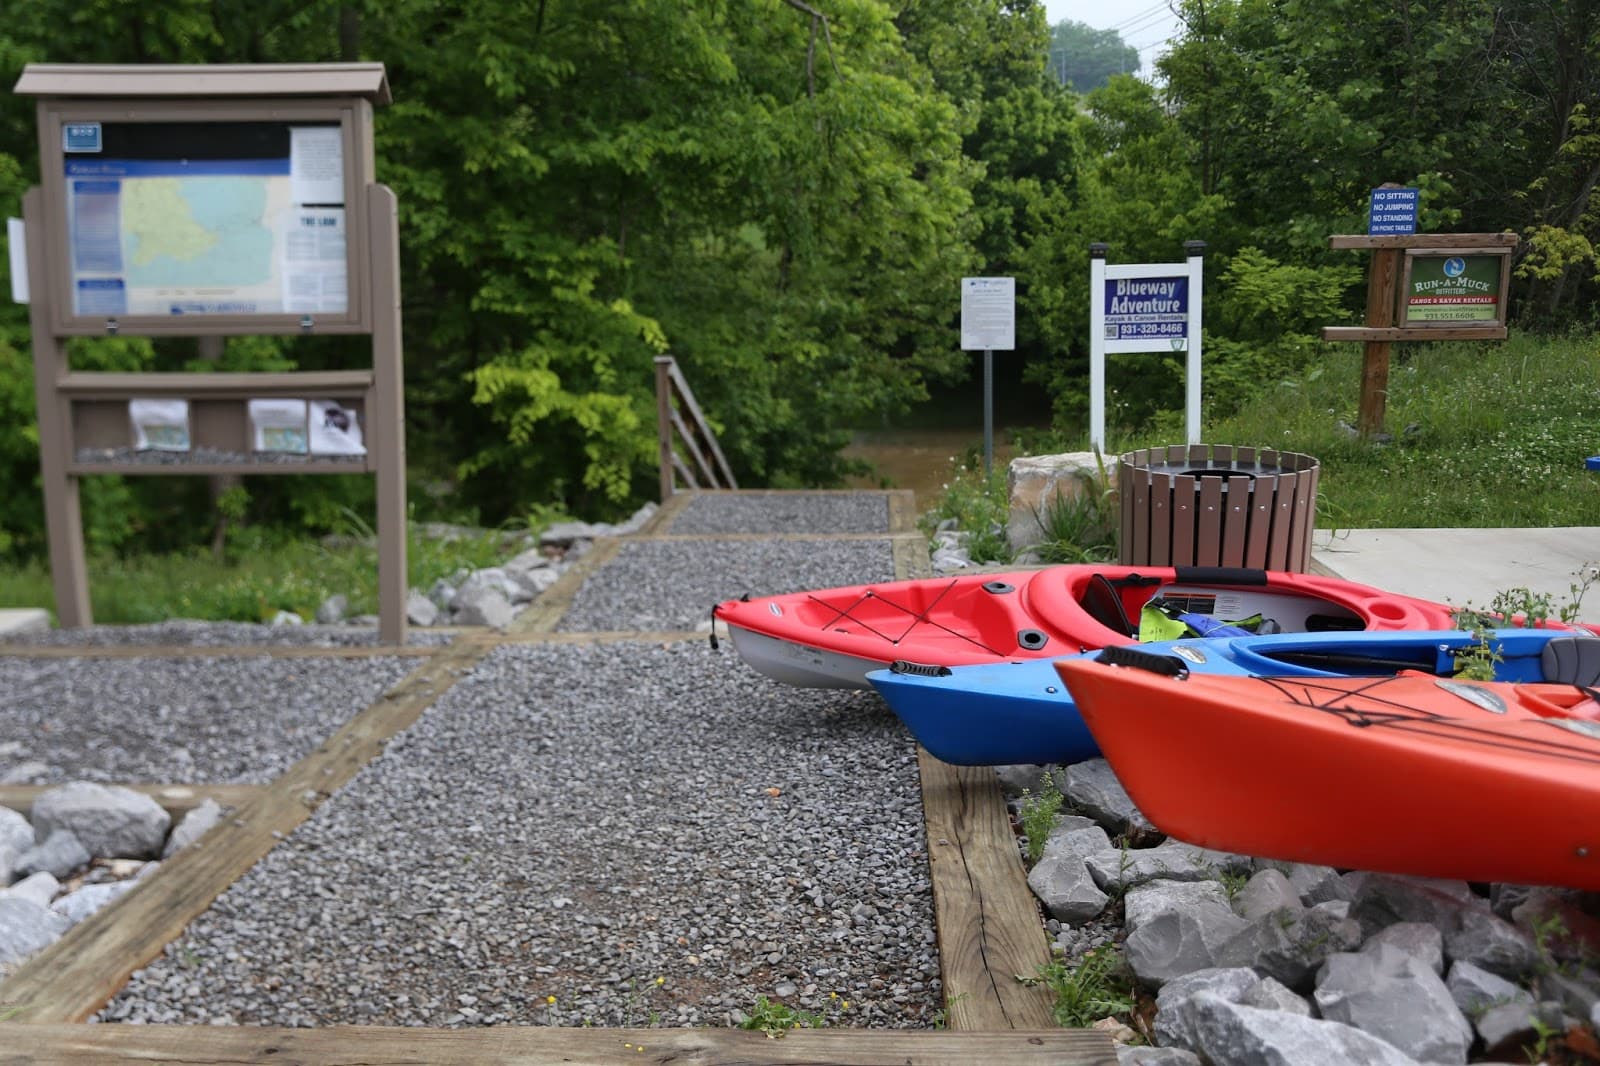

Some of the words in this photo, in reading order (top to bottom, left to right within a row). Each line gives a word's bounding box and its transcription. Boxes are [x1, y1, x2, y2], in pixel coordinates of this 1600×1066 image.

[1374, 192, 1386, 200] NO
[1387, 192, 1415, 200] SITTING
[1373, 203, 1384, 211] NO
[1372, 214, 1383, 222] NO
[1117, 279, 1175, 298] Blueway
[1414, 277, 1490, 292] RUN-A-MUCK
[1435, 287, 1467, 295] OUTFITTERS
[1110, 296, 1180, 314] Adventure
